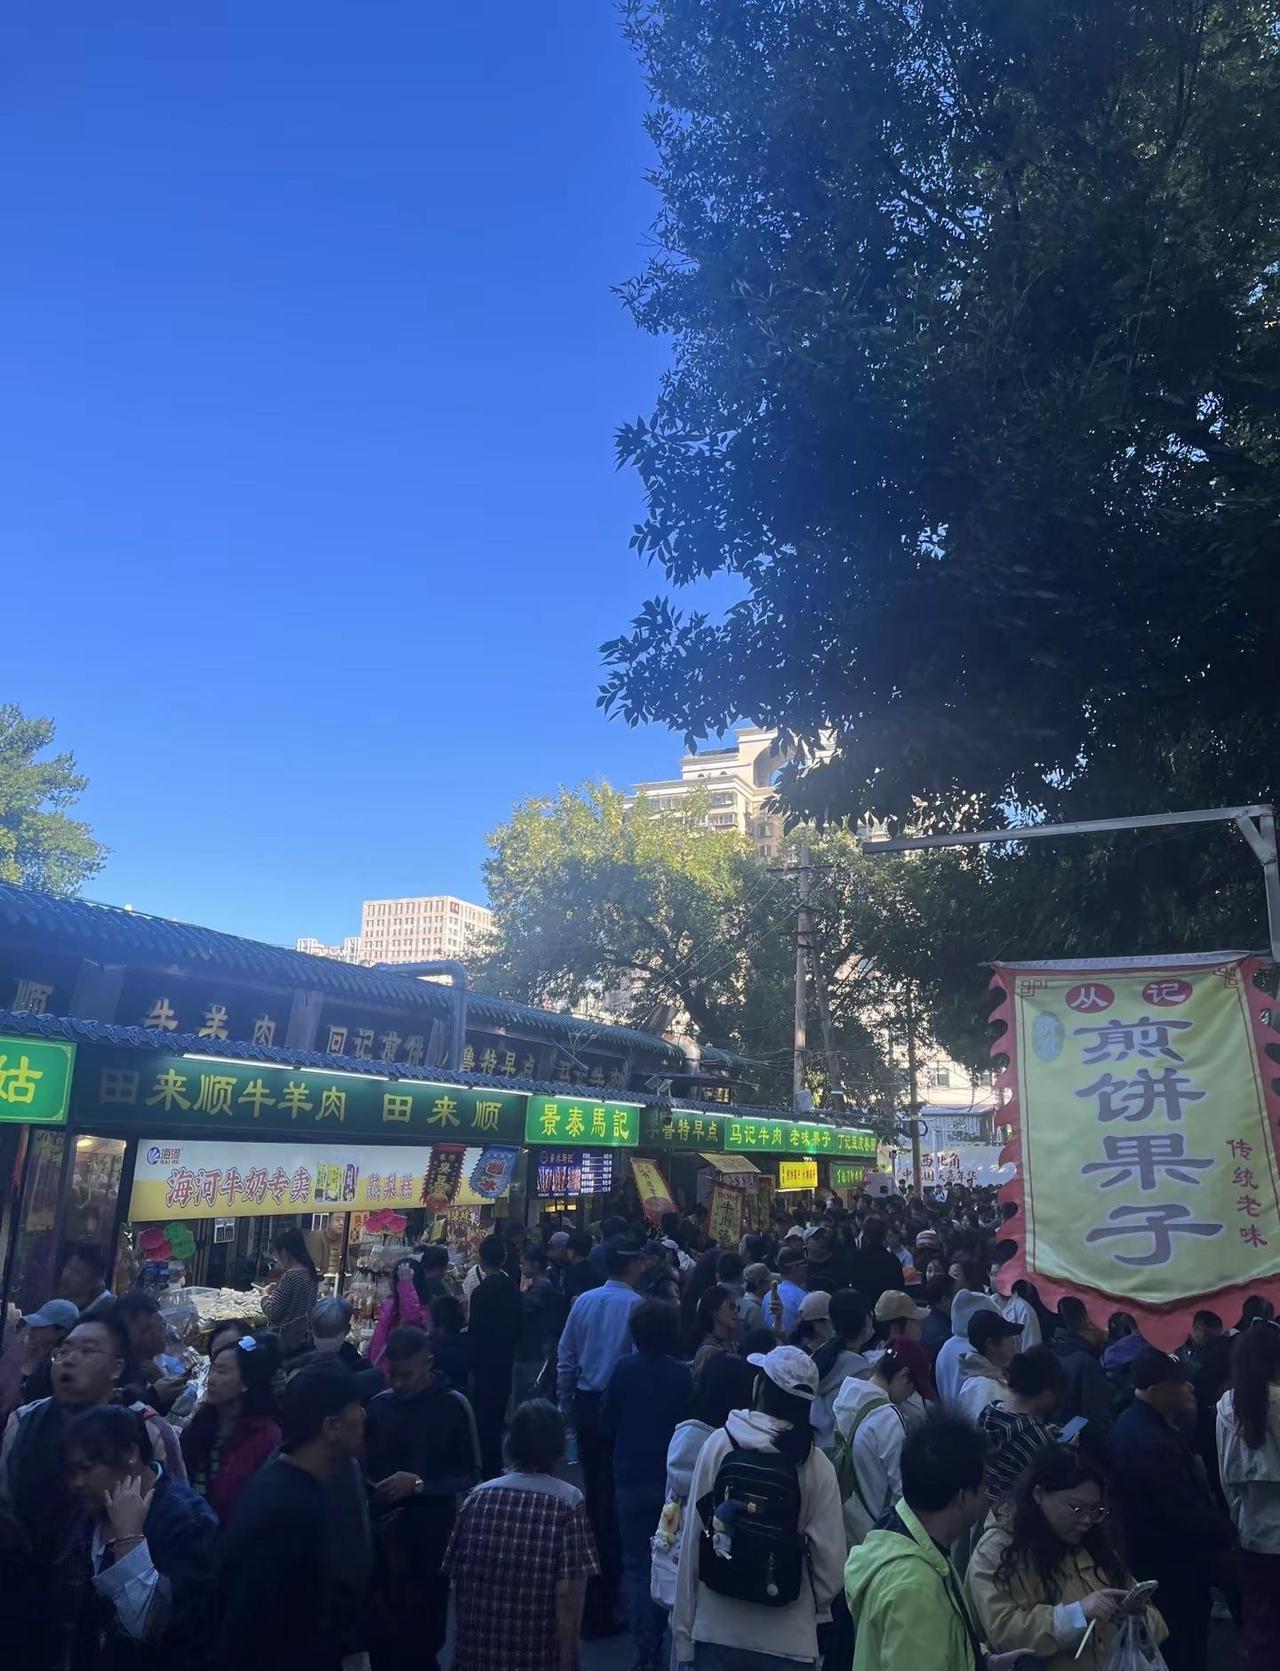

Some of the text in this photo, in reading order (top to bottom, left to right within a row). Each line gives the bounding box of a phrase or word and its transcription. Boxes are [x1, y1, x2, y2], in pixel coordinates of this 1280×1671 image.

[1069, 983, 1187, 1009] 从记
[144, 998, 276, 1047] 牛羊肉
[101, 1068, 502, 1131] 田来顺牛羊肉 田来顺
[539, 1104, 630, 1141] 景泰馬記
[730, 1124, 782, 1146] 马记牛肉
[1072, 1016, 1224, 1267] 煎饼果子
[921, 1152, 960, 1170] 西北角
[165, 1166, 312, 1208] 海河牛奶专卖
[1226, 1138, 1268, 1249] 传统老味
